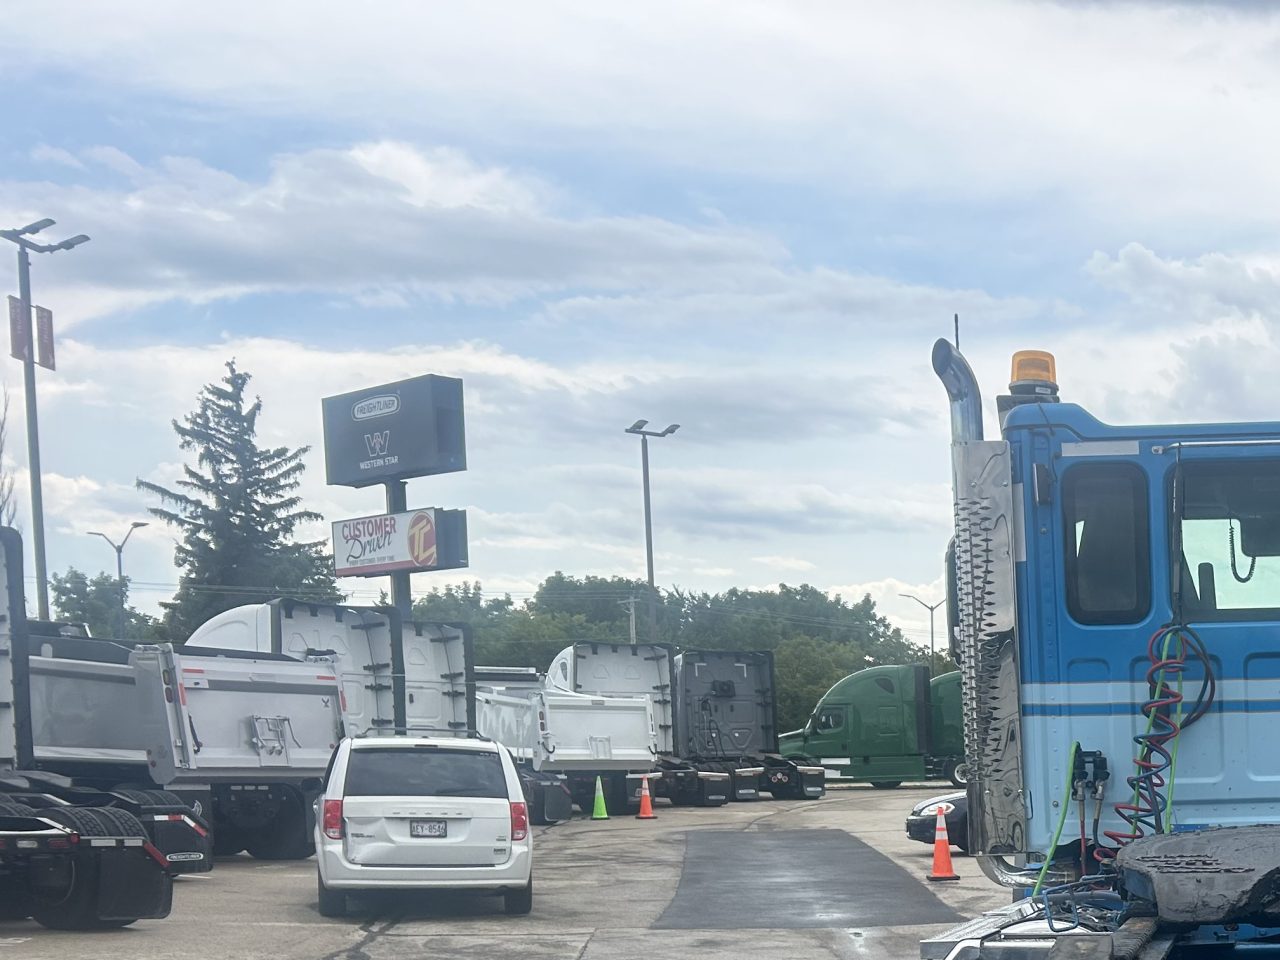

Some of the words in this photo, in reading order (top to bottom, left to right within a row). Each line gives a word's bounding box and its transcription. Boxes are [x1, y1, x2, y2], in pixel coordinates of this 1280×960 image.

[357, 399, 396, 416] FREIGHTLINER
[360, 459, 385, 470] WESTERN
[385, 455, 399, 466] STAR
[342, 516, 397, 540] CUSTOMER
